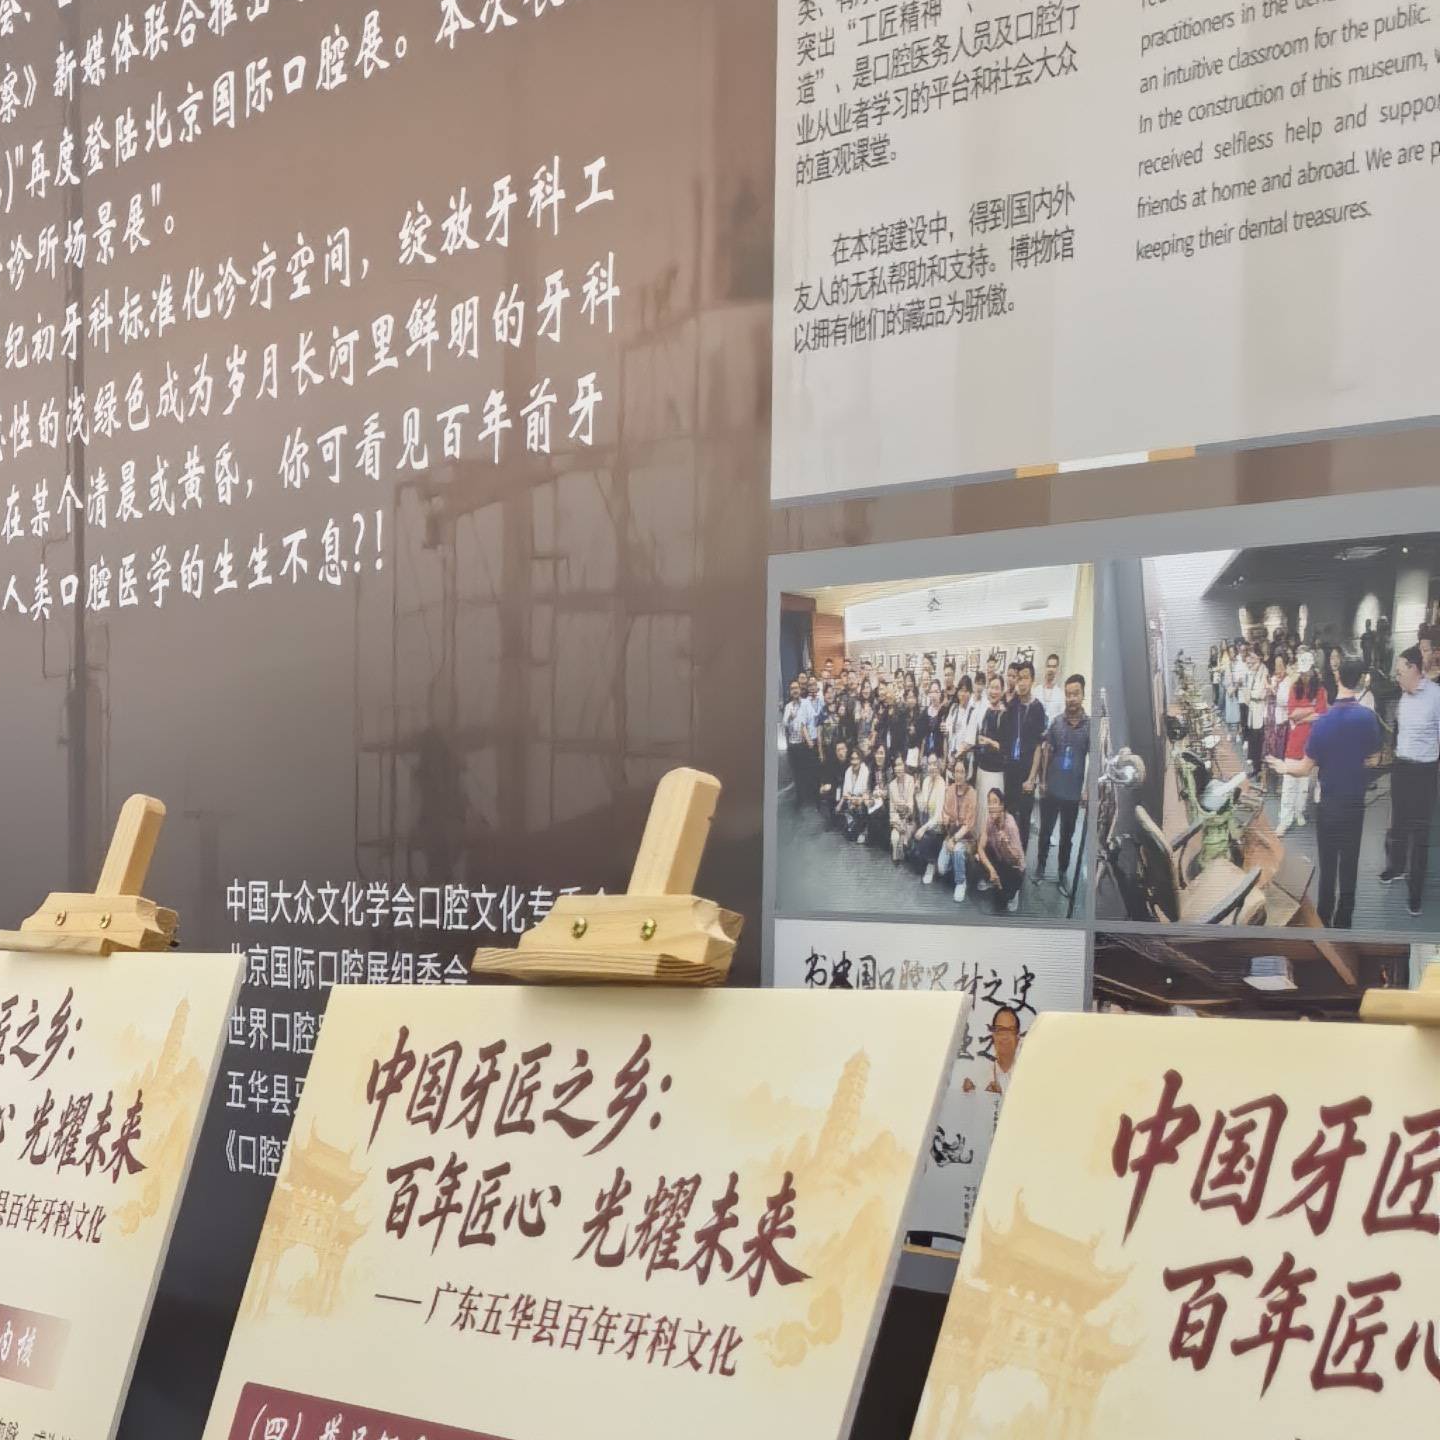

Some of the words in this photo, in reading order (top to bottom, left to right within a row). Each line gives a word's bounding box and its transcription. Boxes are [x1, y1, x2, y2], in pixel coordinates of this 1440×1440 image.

[1140, 10, 1235, 57] practitioners
[1241, 2, 1256, 23] in
[797, 46, 1079, 145] 业从业者学习的平台和社会大众
[1140, 114, 1153, 135] In
[1158, 105, 1183, 130] the
[1187, 84, 1284, 124] construction
[1290, 73, 1308, 98] of
[1313, 66, 1341, 92] this
[1348, 50, 1427, 85] museum,
[796, 134, 897, 186] 的直观课堂。
[1137, 187, 1187, 218] friends
[1192, 184, 1206, 208] at
[1211, 173, 1257, 204] home
[1261, 165, 1292, 194] and
[1297, 152, 1360, 186] abroad.
[1365, 147, 1391, 171] We
[1397, 139, 1424, 165] are
[833, 182, 1076, 264] 在本馆建设中，得到国内外
[1136, 234, 1195, 261] keeping
[1199, 221, 1232, 250] their
[1239, 210, 1288, 242] dental
[1293, 199, 1371, 230] treasures.
[795, 227, 1074, 315] 友人的无私帮助和支持。博物馆
[227, 879, 610, 934] 中国大众文化学会口腔文化专
[228, 1007, 325, 1054] 世界口腔
[19, 1088, 145, 1182] 光耀未来
[226, 1129, 289, 1176] 《口腔
[385, 1152, 561, 1250] 百年匠心
[576, 1167, 807, 1295] 光耀未来
